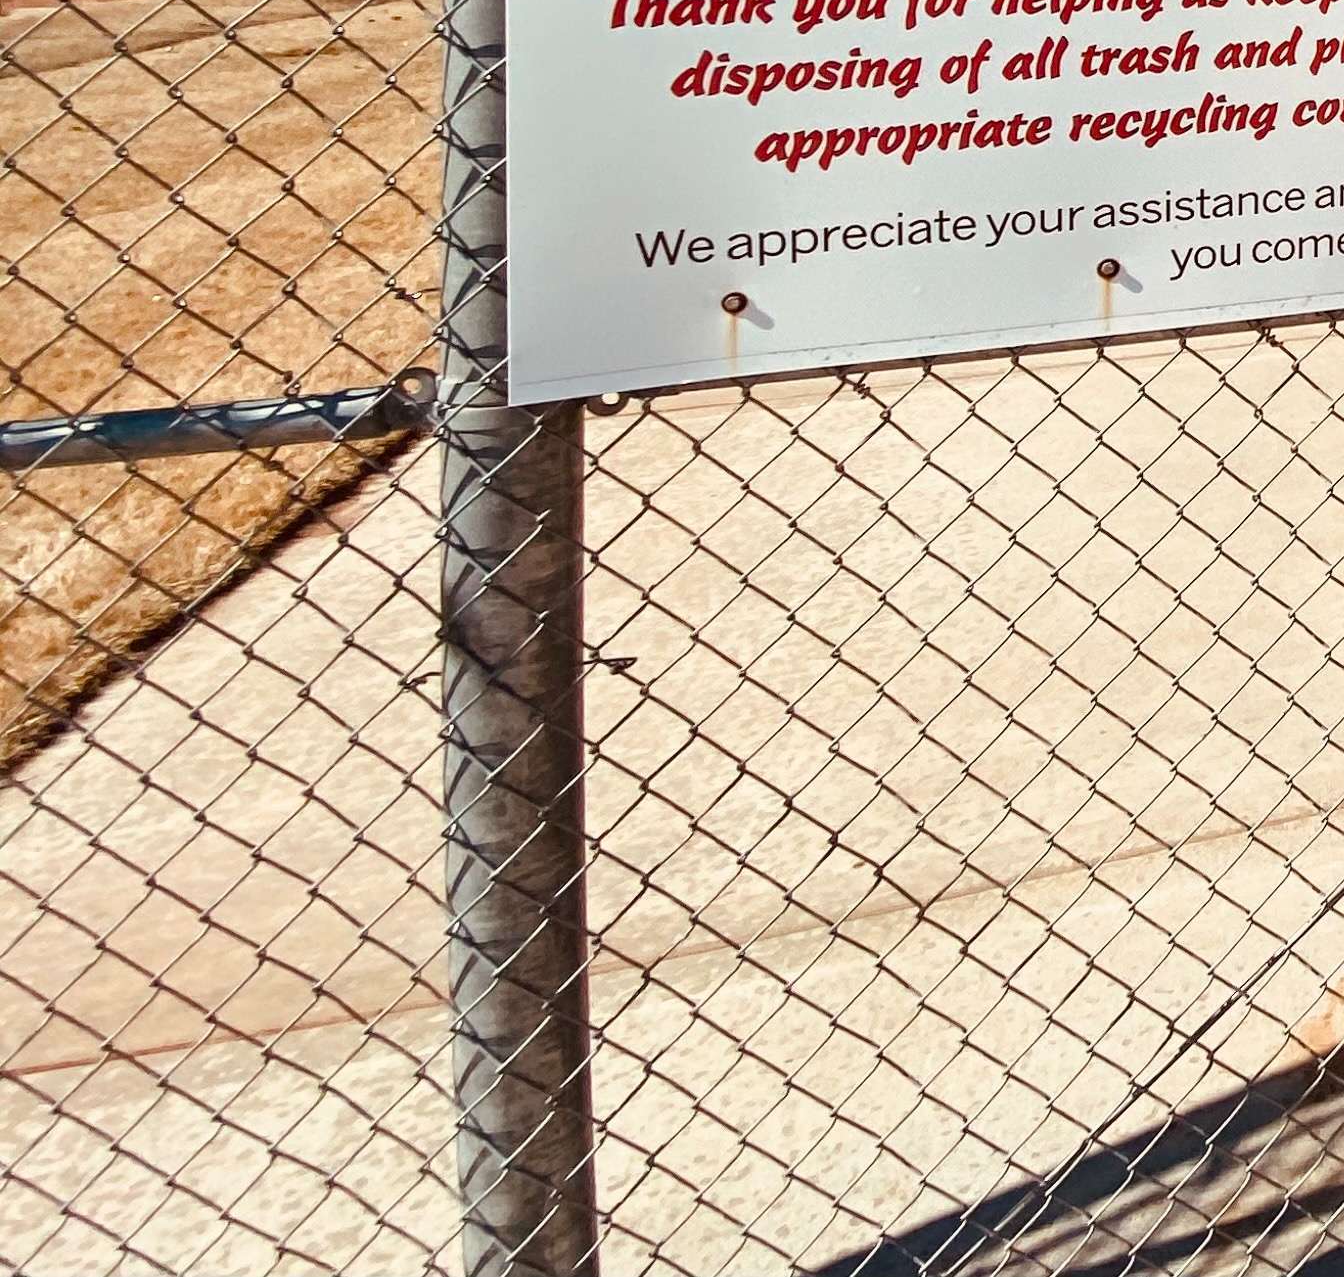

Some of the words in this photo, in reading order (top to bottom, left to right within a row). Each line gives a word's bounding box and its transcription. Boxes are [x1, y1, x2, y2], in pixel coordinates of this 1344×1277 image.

[670, 47, 923, 107] disposing
[939, 38, 993, 95] of
[1001, 35, 1070, 81] all
[1080, 29, 1200, 78] trash
[1213, 25, 1304, 71] and
[754, 108, 1053, 173] appropriate
[1068, 91, 1279, 149] recycling
[634, 228, 715, 268] We
[727, 209, 977, 267] appreciate
[985, 206, 1085, 248] your
[1093, 187, 1306, 229] assistance
[1169, 242, 1241, 281] you
